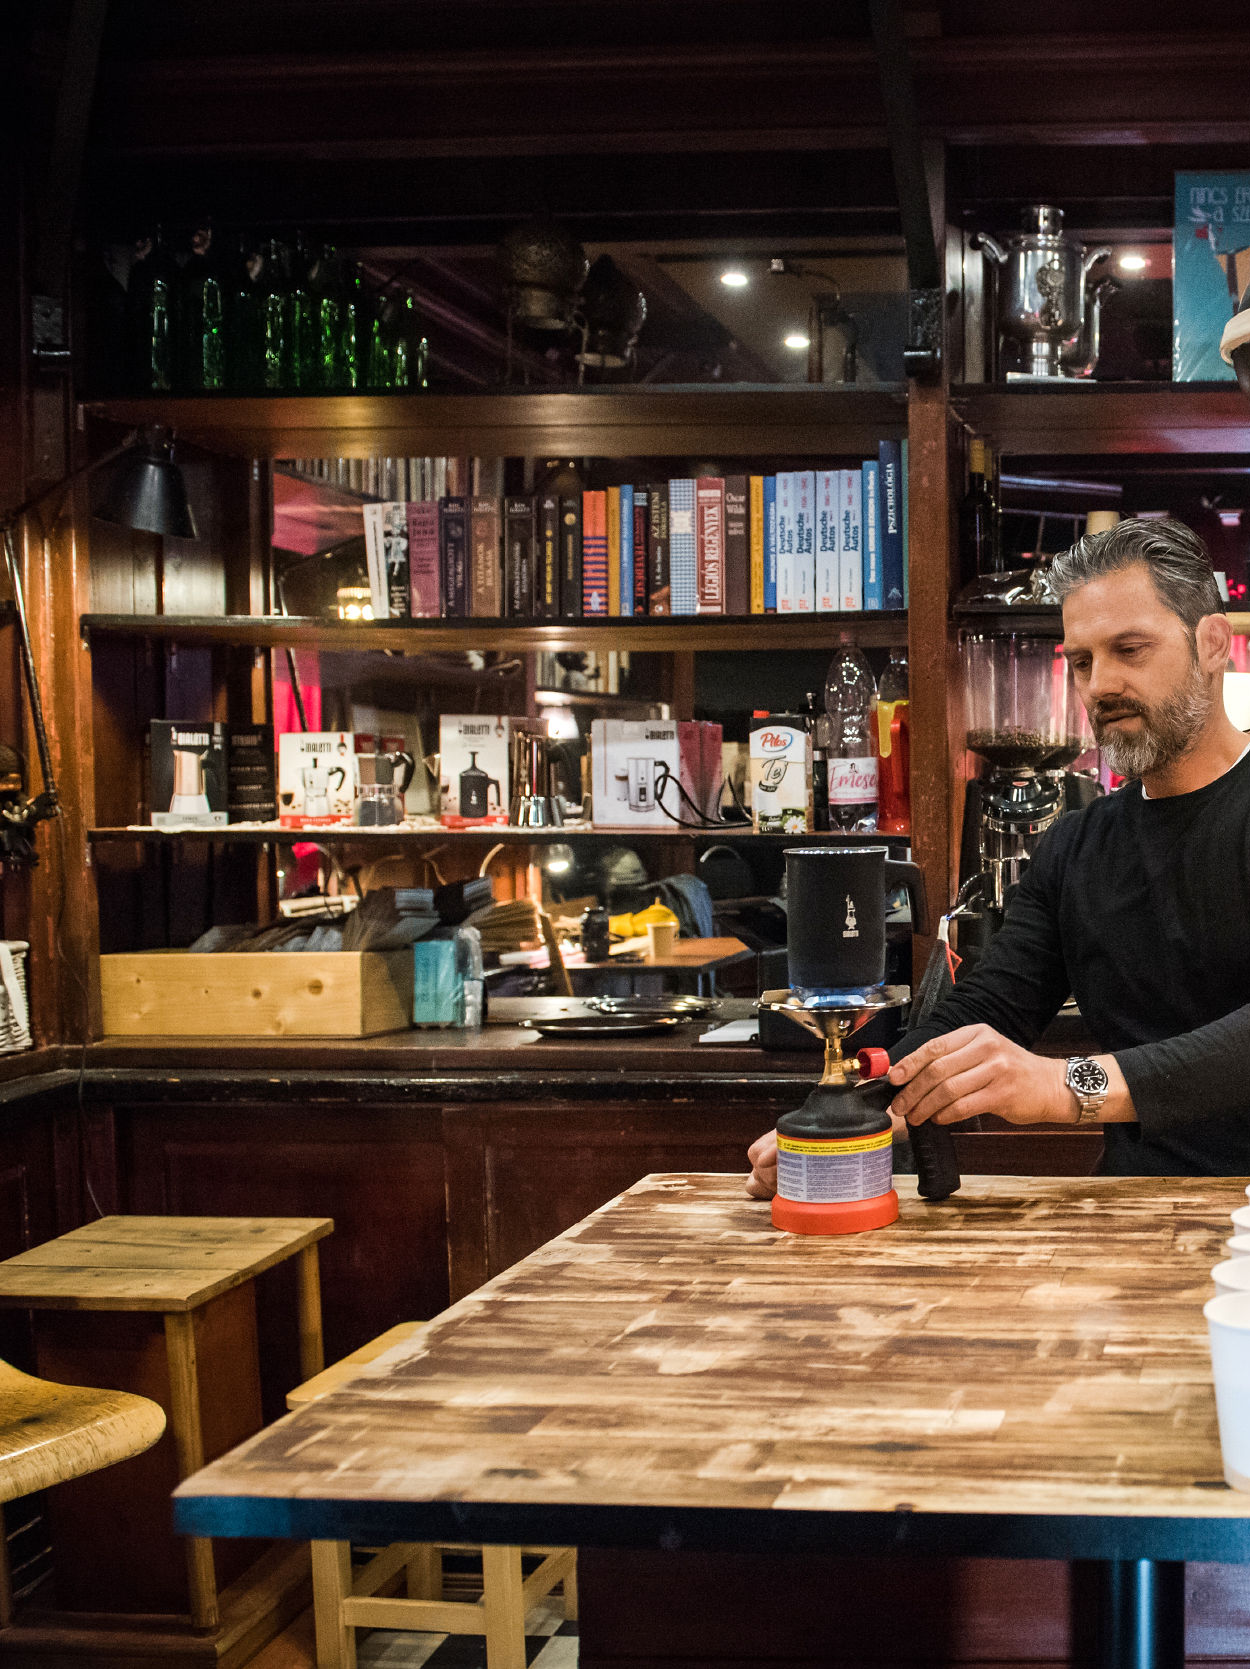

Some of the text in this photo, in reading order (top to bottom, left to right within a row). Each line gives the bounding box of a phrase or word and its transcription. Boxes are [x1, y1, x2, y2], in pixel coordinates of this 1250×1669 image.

[884, 462, 898, 534] PSZICHOLÓGIA
[796, 512, 804, 554] Deutsche
[804, 528, 813, 554] Autos
[820, 510, 828, 552] Deutsche
[828, 526, 836, 552] Autos
[850, 525, 858, 552] Autos
[177, 732, 210, 746] BIALETTI
[463, 723, 490, 735] BIALETTI
[649, 729, 675, 741] BIALETTI
[760, 732, 787, 748] Pilos
[305, 742, 331, 753] BIALETTI
